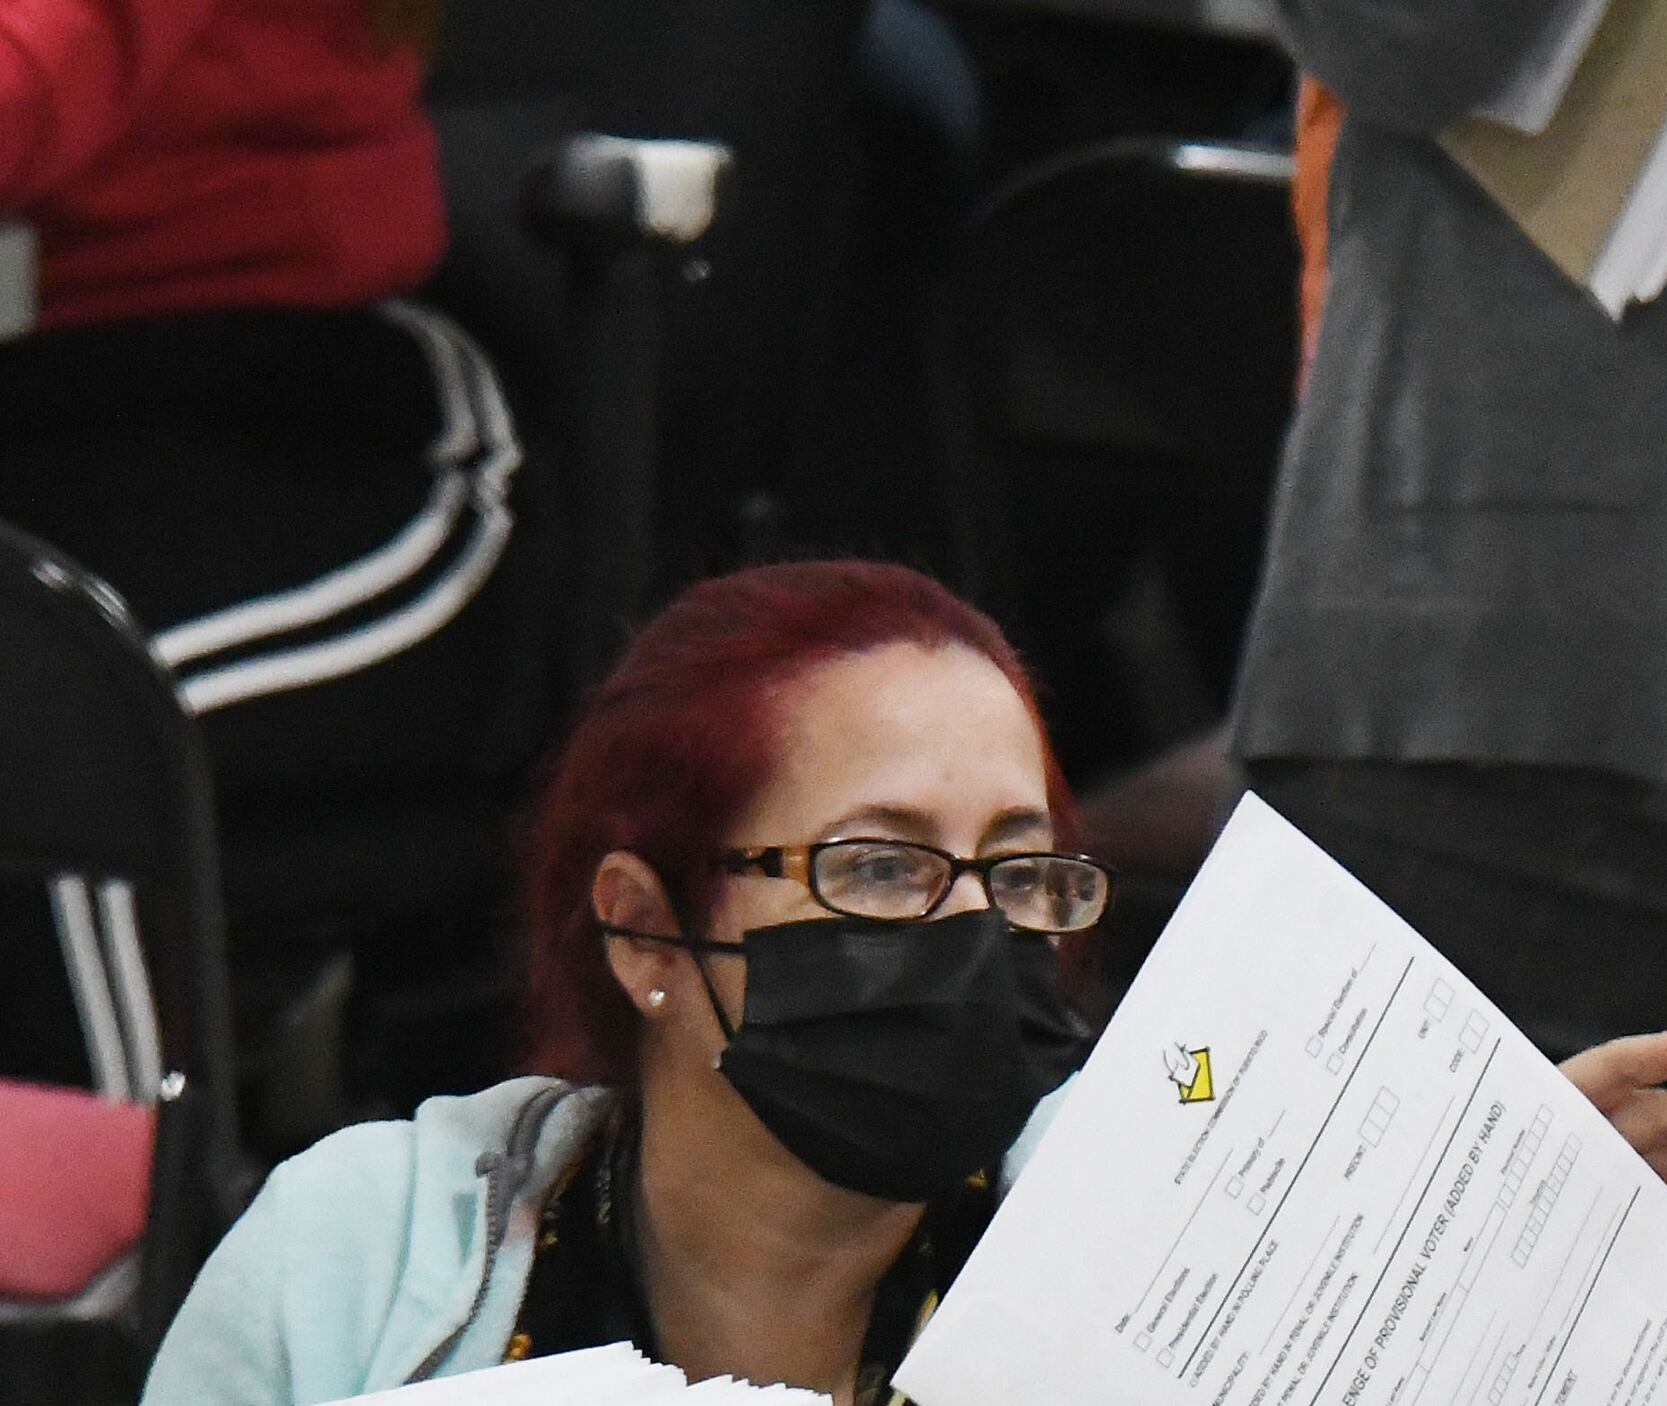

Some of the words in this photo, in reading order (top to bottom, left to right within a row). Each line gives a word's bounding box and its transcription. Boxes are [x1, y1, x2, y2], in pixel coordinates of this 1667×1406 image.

[1475, 1097, 1507, 1146] HAND)
[1467, 1141, 1485, 1165] BY
[1441, 1160, 1478, 1218] (ADDED
[1418, 1212, 1451, 1262] VOTER
[1372, 1257, 1428, 1350] PROVISIONAL
[1362, 1346, 1381, 1371] OF
